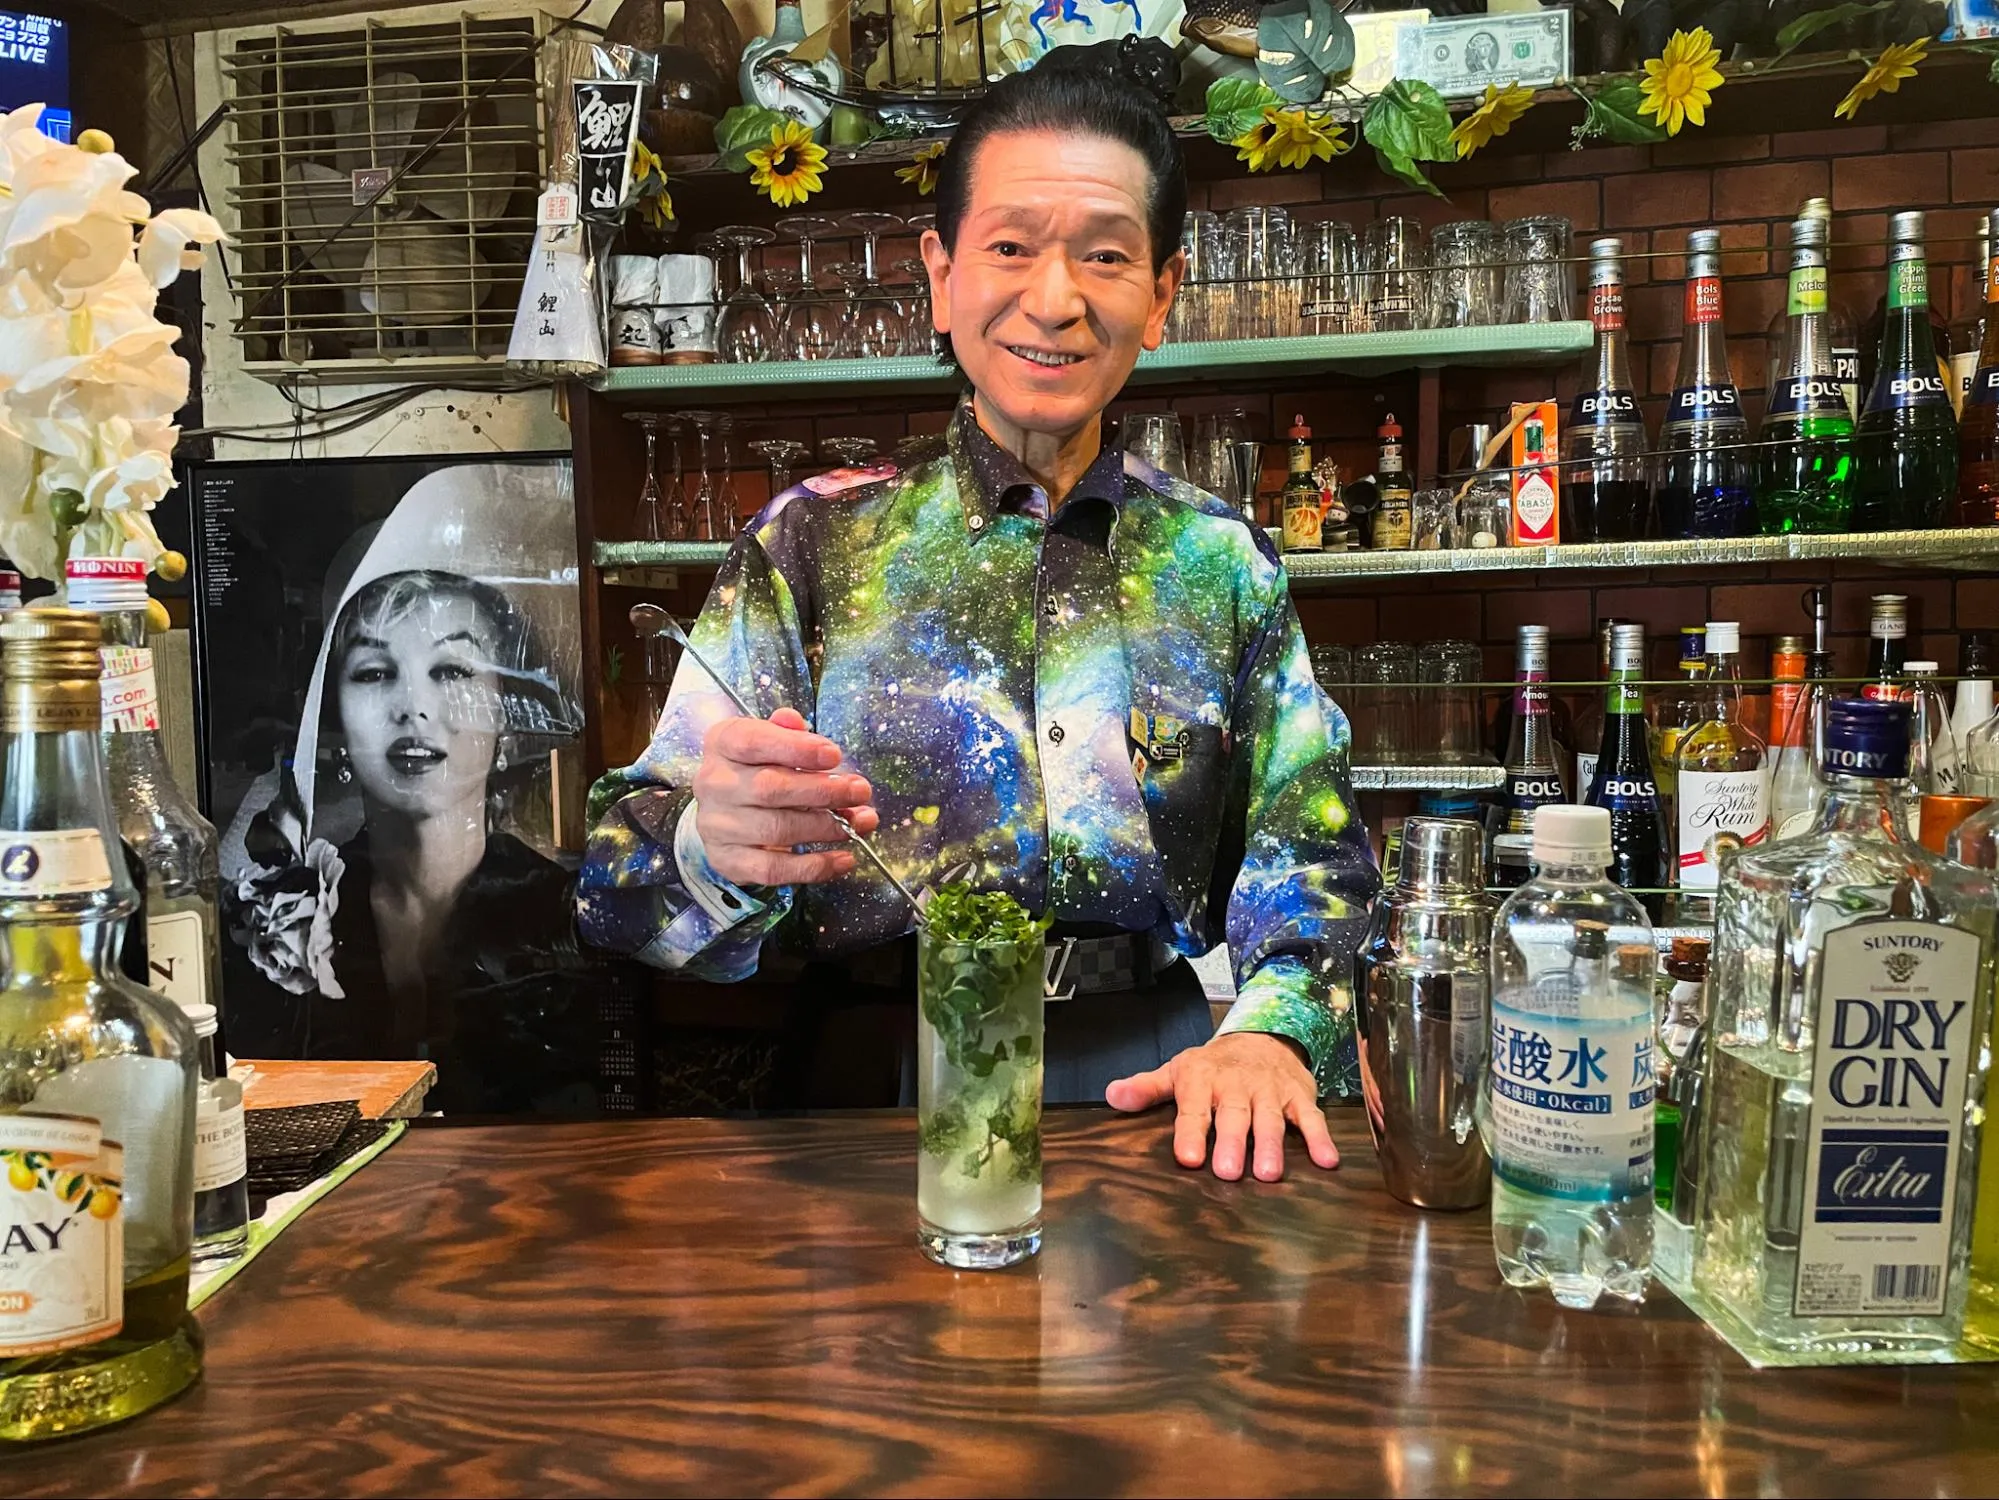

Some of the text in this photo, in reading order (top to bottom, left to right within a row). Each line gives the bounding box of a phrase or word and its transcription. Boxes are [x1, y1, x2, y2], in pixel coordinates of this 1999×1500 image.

[0, 41, 48, 64] LIVE
[1696, 284, 1718, 295] Bols
[1594, 294, 1622, 304] Cacao
[1696, 295, 1718, 305] Blue
[1593, 305, 1623, 315] Brown
[1789, 381, 1842, 399] BOLS
[1890, 377, 1944, 395] BOLS
[1581, 396, 1634, 413] BOLS
[1680, 389, 1735, 407] BOLS
[1518, 497, 1553, 508] TABASCO
[1623, 689, 1639, 699] Tea
[1514, 781, 1562, 796] BOLS
[1604, 780, 1656, 796] BOLS
[1704, 778, 1759, 797] Suntory
[1718, 794, 1758, 812] White
[1689, 803, 1756, 829] Rum
[1863, 935, 1944, 952] SUNTORY
[1830, 999, 1967, 1051] DRY
[1829, 1055, 1950, 1108] GIN
[1833, 1146, 1932, 1205] Extra
